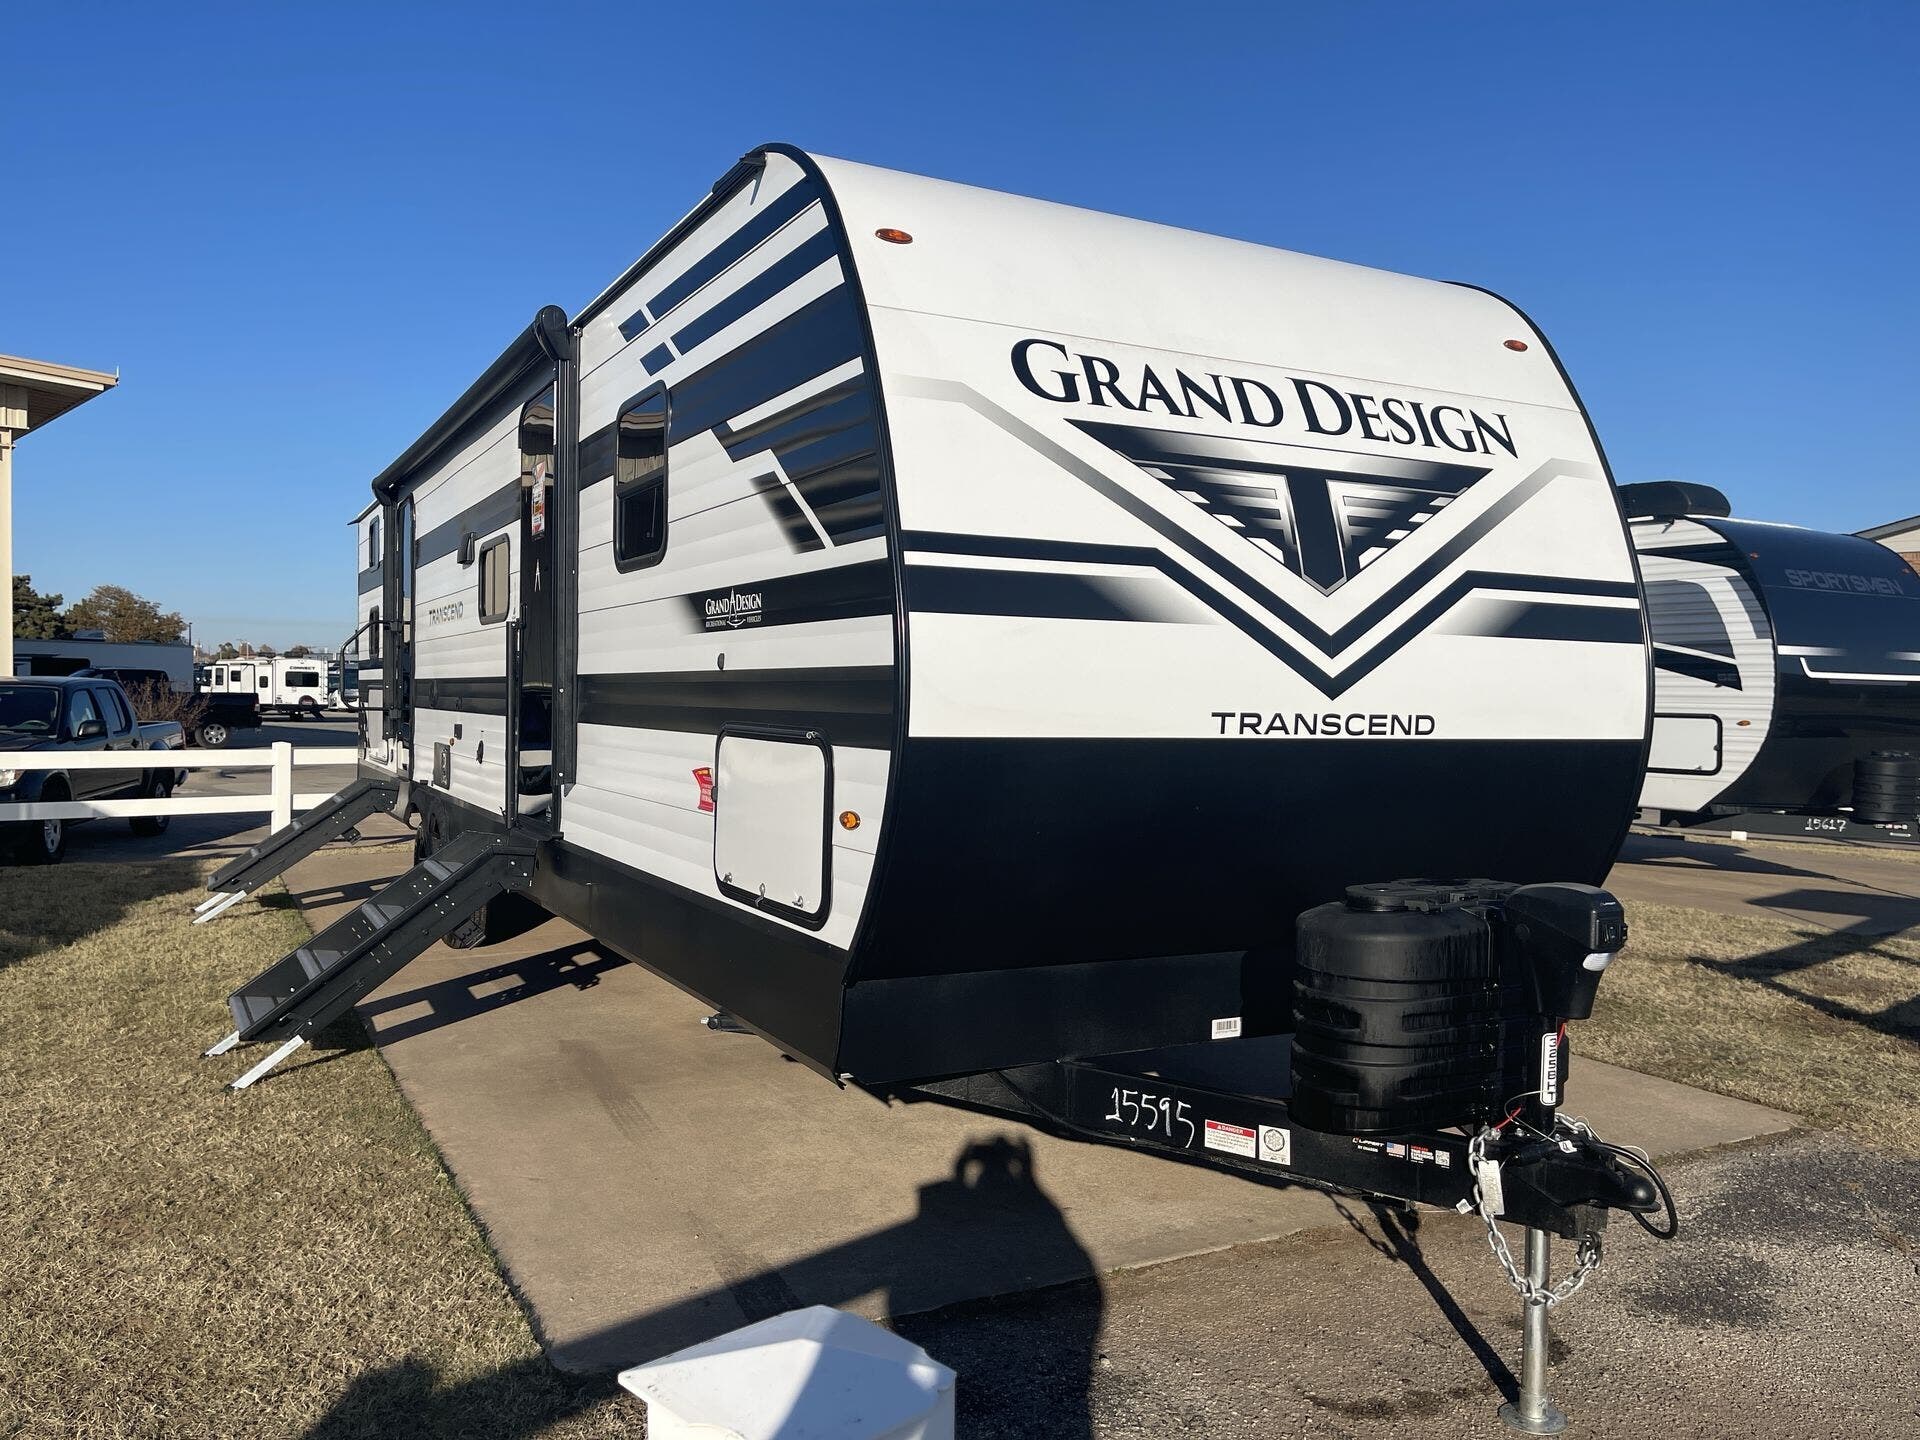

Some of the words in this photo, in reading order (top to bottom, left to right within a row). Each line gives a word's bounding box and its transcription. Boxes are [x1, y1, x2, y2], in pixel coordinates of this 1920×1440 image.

[1010, 338, 1284, 427] GRAND
[1285, 377, 1519, 459] DESIGN
[1784, 568, 1904, 595] SPORTSMEN
[429, 600, 464, 627] TRANSCEND
[705, 598, 729, 615] GRAND
[735, 592, 762, 611] DESIGN
[1211, 711, 1436, 737] TRANSCEND
[1804, 818, 1847, 832] 15617
[1105, 1087, 1195, 1149] 15595
